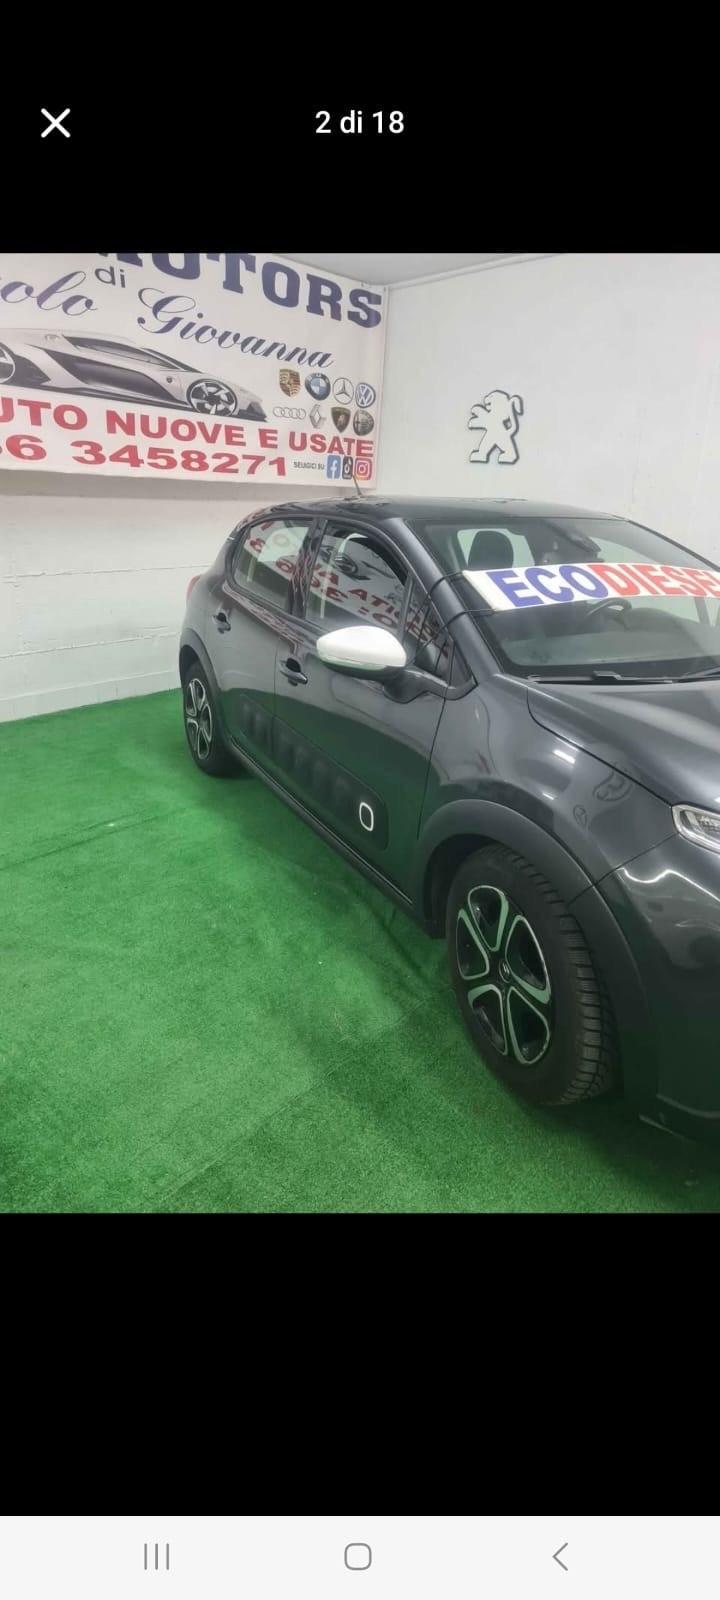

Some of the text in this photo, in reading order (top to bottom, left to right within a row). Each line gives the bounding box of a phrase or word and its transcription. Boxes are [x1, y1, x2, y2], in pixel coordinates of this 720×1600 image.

[94, 265, 126, 288] di
[99, 252, 383, 329] OTORS
[0, 271, 336, 369] olo Giovanna
[0, 434, 287, 477] 6 3458271
[106, 409, 247, 446] NUOVE
[258, 427, 279, 449] E
[288, 431, 374, 458] USATE
